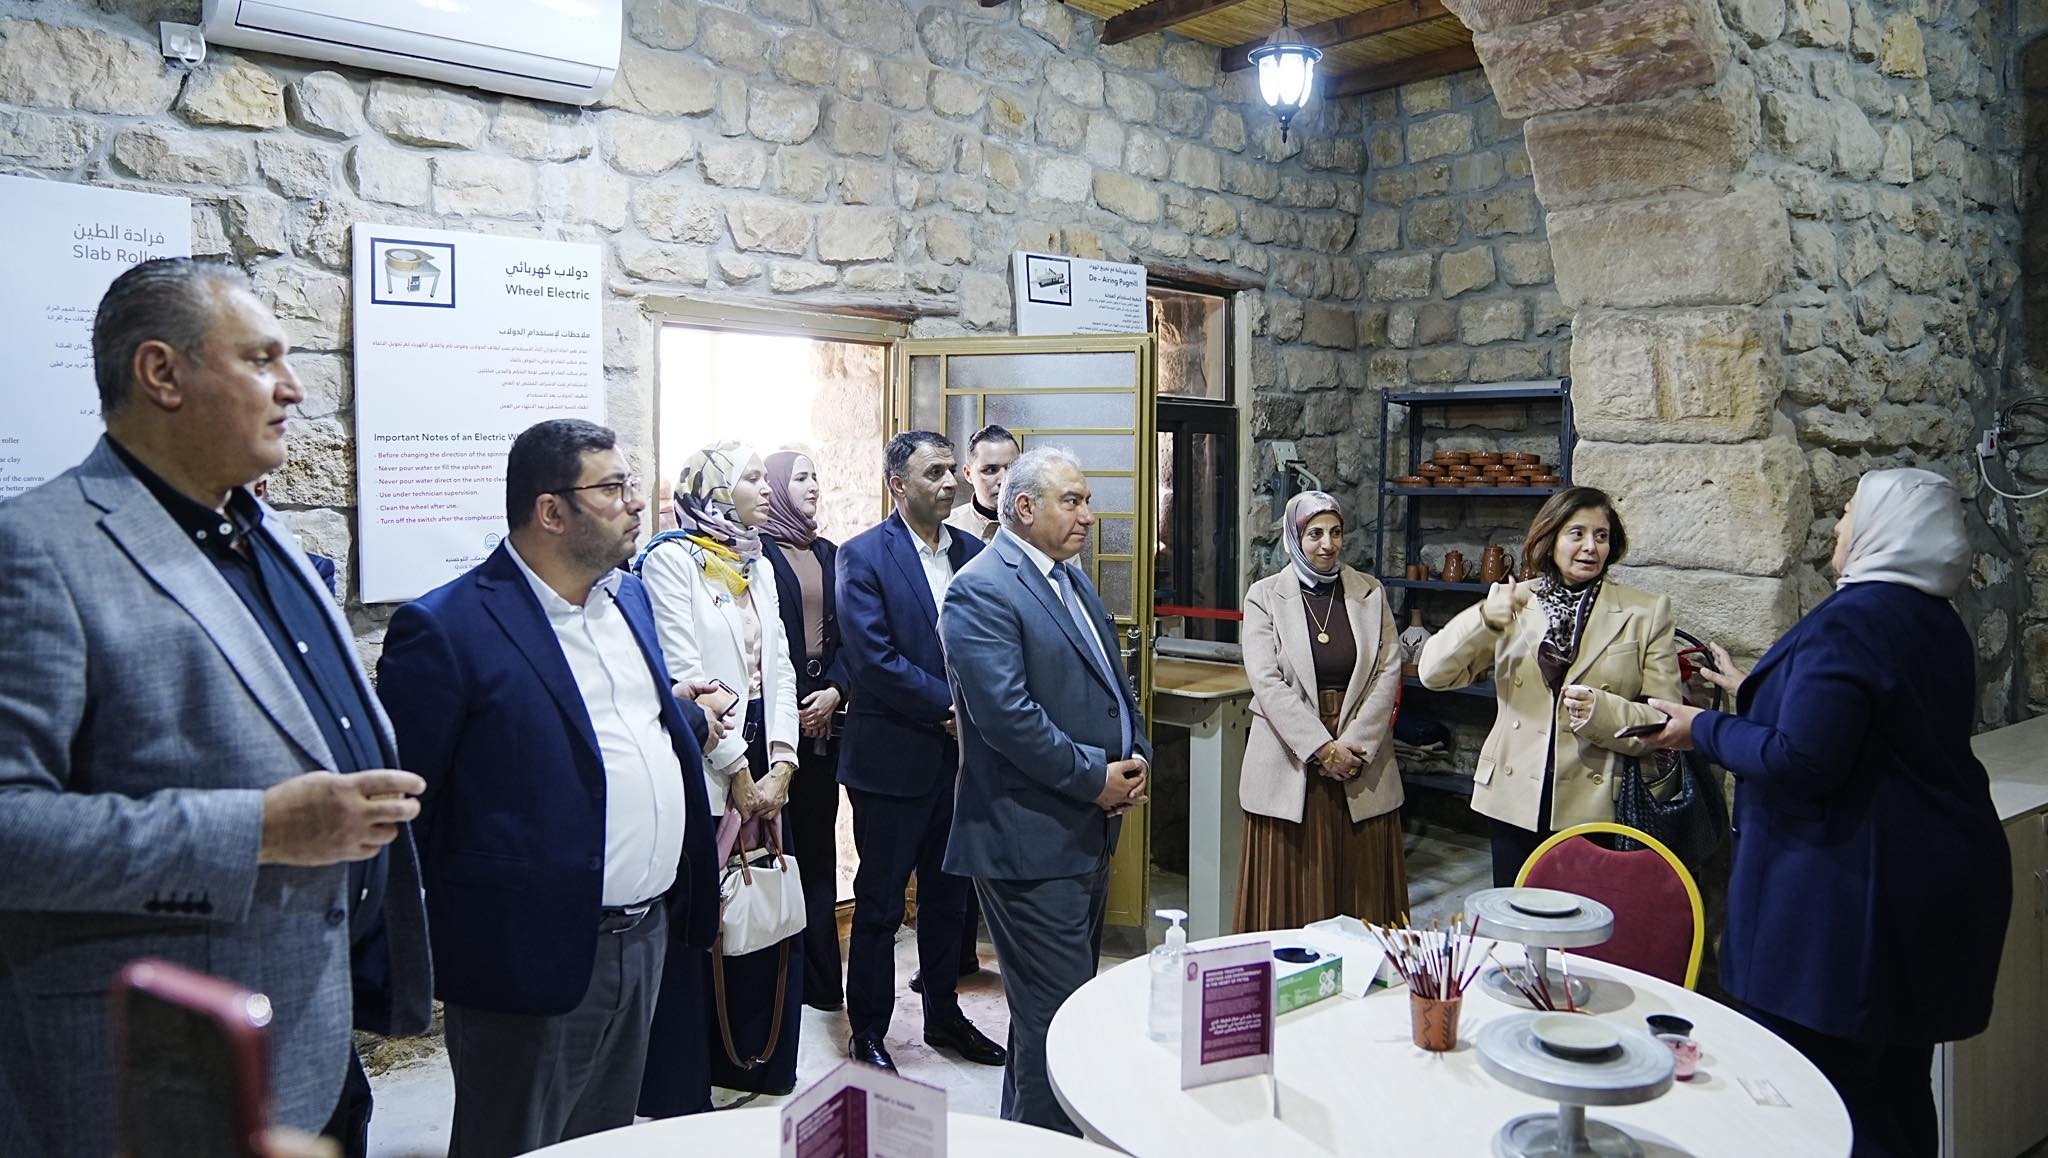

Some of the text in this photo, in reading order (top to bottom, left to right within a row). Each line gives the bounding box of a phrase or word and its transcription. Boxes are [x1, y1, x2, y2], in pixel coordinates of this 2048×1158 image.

[73, 222, 165, 246] فرادة الطين
[72, 244, 166, 265] Slab Rolle
[505, 261, 588, 280] دولاب كهربائي
[1088, 273, 1098, 282] De
[1102, 276, 1119, 286] Airing
[1119, 278, 1139, 288] Pugmill
[505, 283, 590, 300] Wheel Electric
[498, 327, 526, 337] الدولاب
[560, 330, 591, 339] ملاحظات
[374, 432, 420, 443] Important
[421, 432, 449, 442] Notes
[451, 432, 461, 442] of
[463, 433, 473, 442] an
[474, 432, 506, 442] Electric
[377, 451, 400, 460] Before
[400, 451, 429, 461] changing
[429, 450, 440, 459] the
[440, 450, 468, 459] direction
[468, 450, 476, 459] of
[475, 450, 486, 458] the
[378, 464, 398, 472] Never
[399, 465, 414, 474] pour
[414, 464, 433, 472] water
[441, 463, 450, 471] fill
[450, 463, 461, 471] the
[461, 463, 481, 473] splash
[481, 465, 493, 473] pan
[378, 478, 398, 486] Never
[399, 479, 414, 487] pour
[415, 478, 434, 486] water
[434, 477, 452, 485] direct
[461, 476, 472, 484] the
[473, 476, 485, 484] unit
[379, 488, 480, 499] Use under technician supervision.
[379, 503, 398, 512] Clean
[399, 503, 410, 511] the
[410, 502, 430, 511] wheel
[430, 502, 446, 511] after
[380, 517, 395, 525] Turn
[395, 516, 405, 524] off
[405, 516, 417, 524] the
[417, 514, 437, 523] switch
[437, 514, 453, 523] after
[453, 514, 464, 522] the
